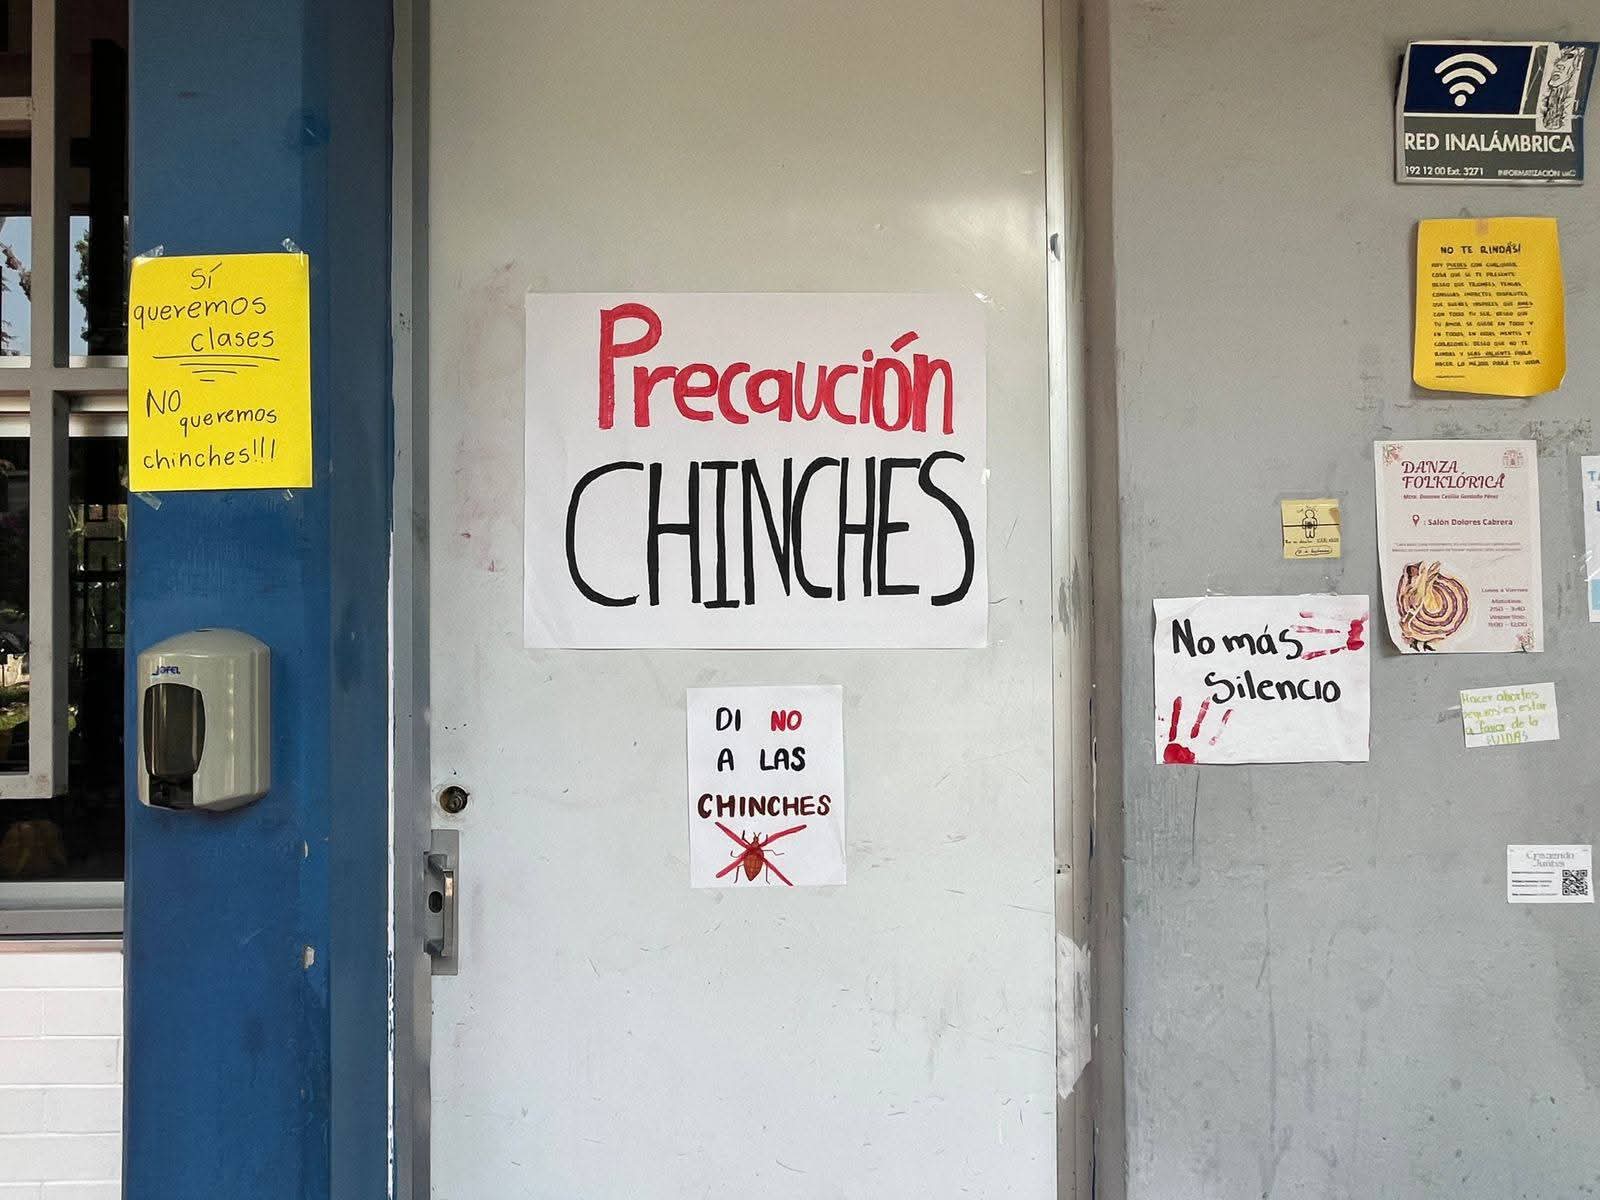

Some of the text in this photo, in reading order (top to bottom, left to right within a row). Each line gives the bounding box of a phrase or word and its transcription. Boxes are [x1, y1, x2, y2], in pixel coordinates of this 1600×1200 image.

[1405, 130, 1575, 153] RED INALÁMBRICA
[1405, 166, 1420, 175] 192
[1423, 166, 1432, 175] 12
[1434, 166, 1445, 175] 00
[1463, 167, 1483, 176] 3271
[1440, 246, 1454, 255] NO
[1461, 246, 1473, 254] TE
[133, 296, 267, 330] queremos
[191, 327, 275, 352] clases
[598, 302, 954, 435] Precaución
[146, 389, 278, 438] NO queremos
[143, 436, 276, 469] chinches!!!
[1401, 460, 1459, 474] DANZA
[1401, 471, 1506, 489] FOLKLÓRICA
[565, 451, 975, 609] CHINCHES
[1428, 518, 1449, 526] Salón
[1171, 618, 1304, 660] No más
[1204, 670, 1341, 704] Silencio
[715, 707, 803, 732] DI NO
[717, 746, 806, 772] A LAS
[697, 793, 832, 819] CHINCHES
